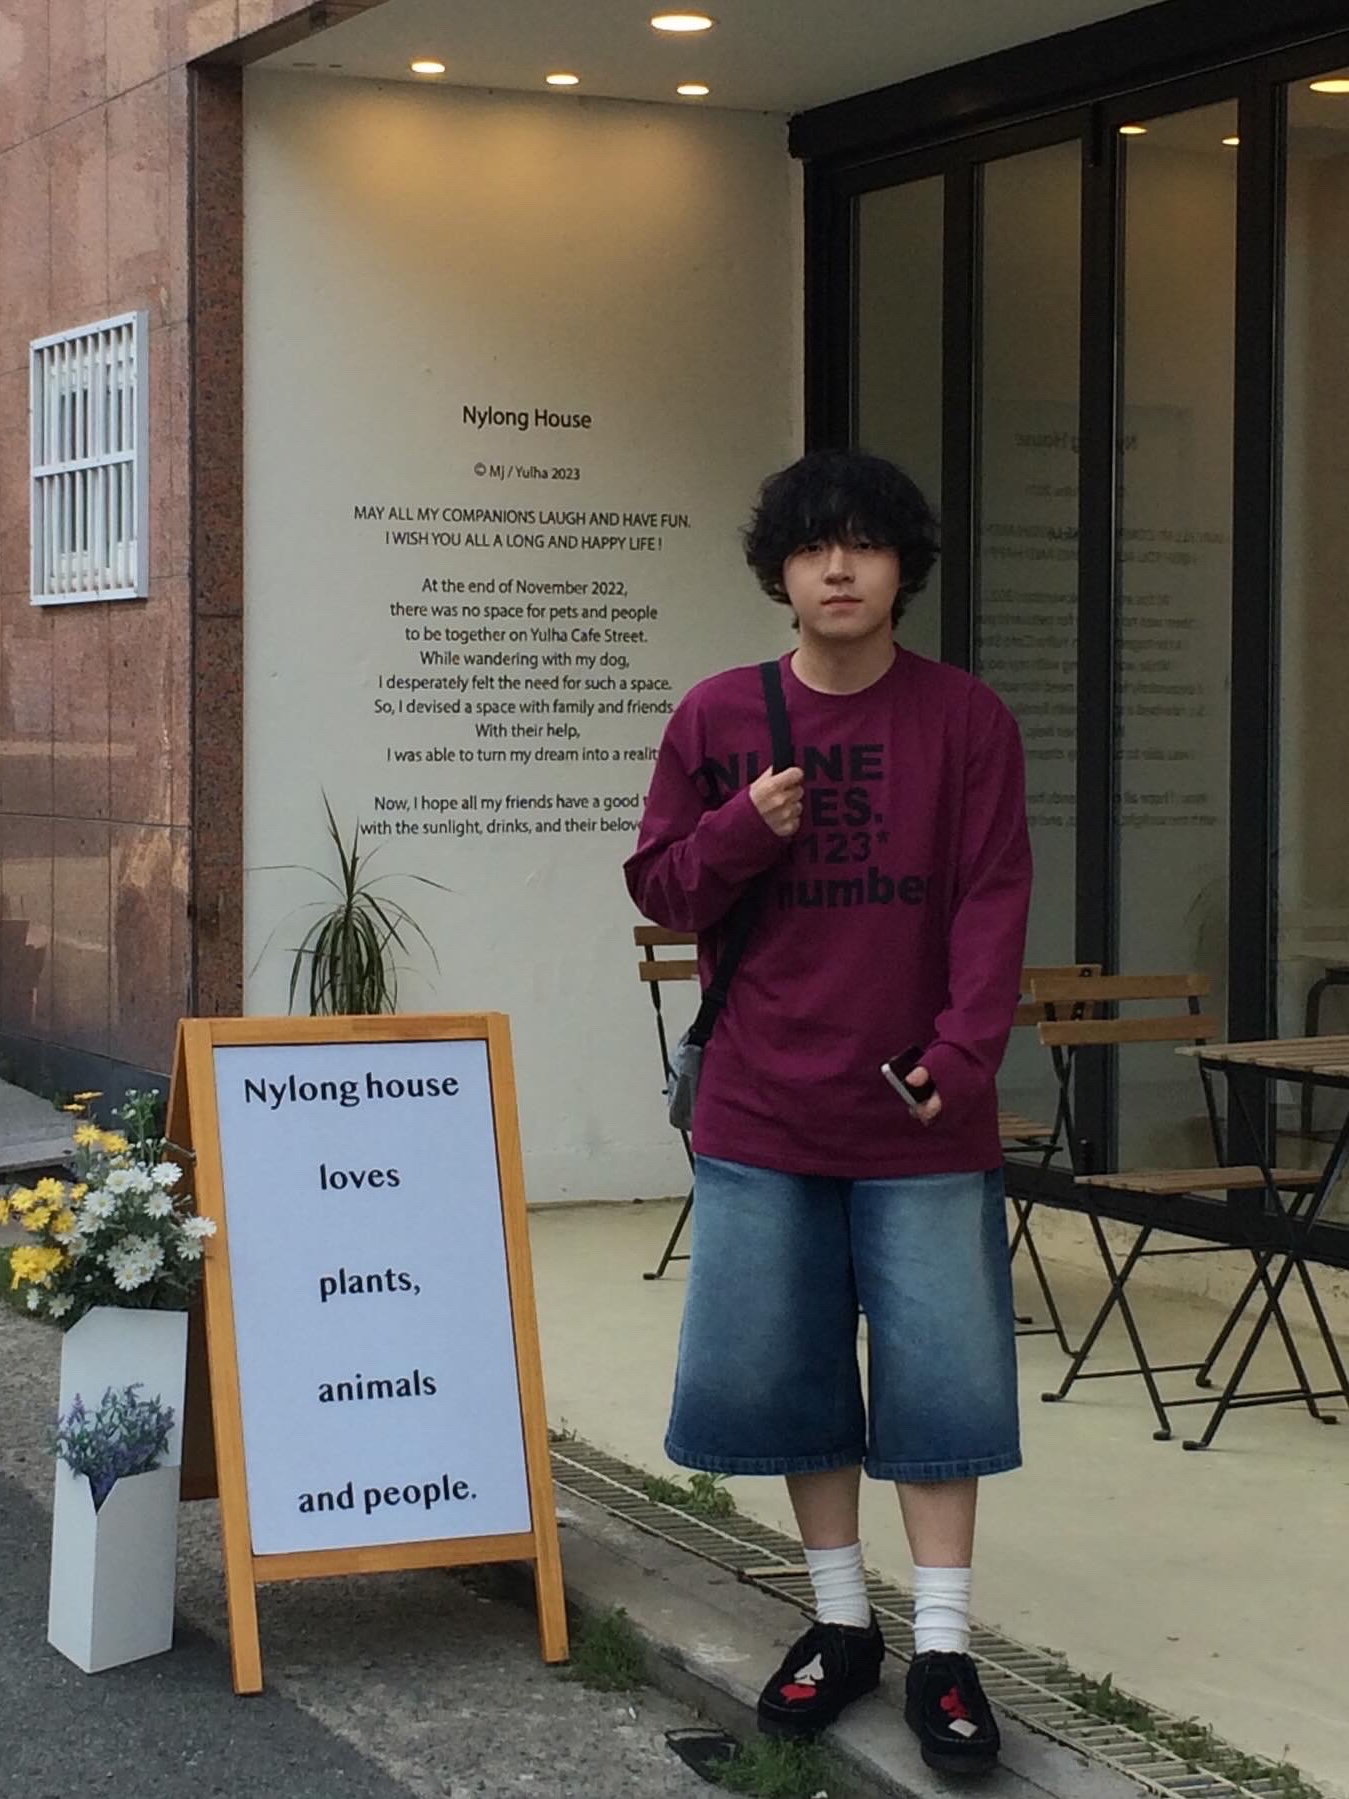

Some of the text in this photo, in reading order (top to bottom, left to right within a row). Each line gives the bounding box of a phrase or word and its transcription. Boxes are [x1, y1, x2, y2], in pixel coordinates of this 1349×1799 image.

[463, 405, 592, 431] Nylong House
[515, 466, 548, 479] Yulha
[551, 468, 580, 480] 2023
[354, 506, 691, 528] MAY ALL MY COMPANIONS LAUGH AND HAVE FUN.
[386, 531, 389, 544] I
[392, 531, 429, 545] WISH
[431, 531, 461, 546] YOU
[464, 533, 490, 547] ALL
[493, 534, 503, 548] A
[506, 534, 545, 548] LONG
[547, 532, 578, 549] AND
[581, 536, 627, 550] HAPPY
[422, 578, 628, 597] At the end of November 2022,
[390, 602, 658, 623] there was no space for pets and people
[405, 625, 648, 645] to be together on Yulha Cafe Street.
[420, 650, 630, 670] While wandering with my dog,
[379, 674, 672, 694] I desperately felt the need for such a space.
[375, 699, 396, 715] So,
[399, 699, 402, 712] I
[406, 699, 461, 713] devised
[464, 702, 472, 714] a
[476, 702, 516, 717] space
[519, 699, 550, 715] with
[552, 698, 595, 717] family
[598, 699, 624, 714] and
[475, 722, 580, 741] With their help,
[388, 746, 659, 765] I was able to turn my dream into a realit
[375, 796, 410, 813] Now,
[414, 796, 417, 810] I
[421, 795, 458, 814] hope
[461, 795, 478, 810] all
[481, 799, 502, 815] my
[505, 794, 553, 809] friends
[556, 793, 589, 808] have
[592, 797, 600, 808] a
[603, 793, 639, 812] good
[360, 816, 641, 837] with the sunlight, drinks, and their belov
[245, 1072, 459, 1110] Nylong house
[320, 1164, 400, 1190] loves
[320, 1268, 420, 1302] plants,
[319, 1369, 436, 1403] animals
[299, 1474, 476, 1515] and people.
